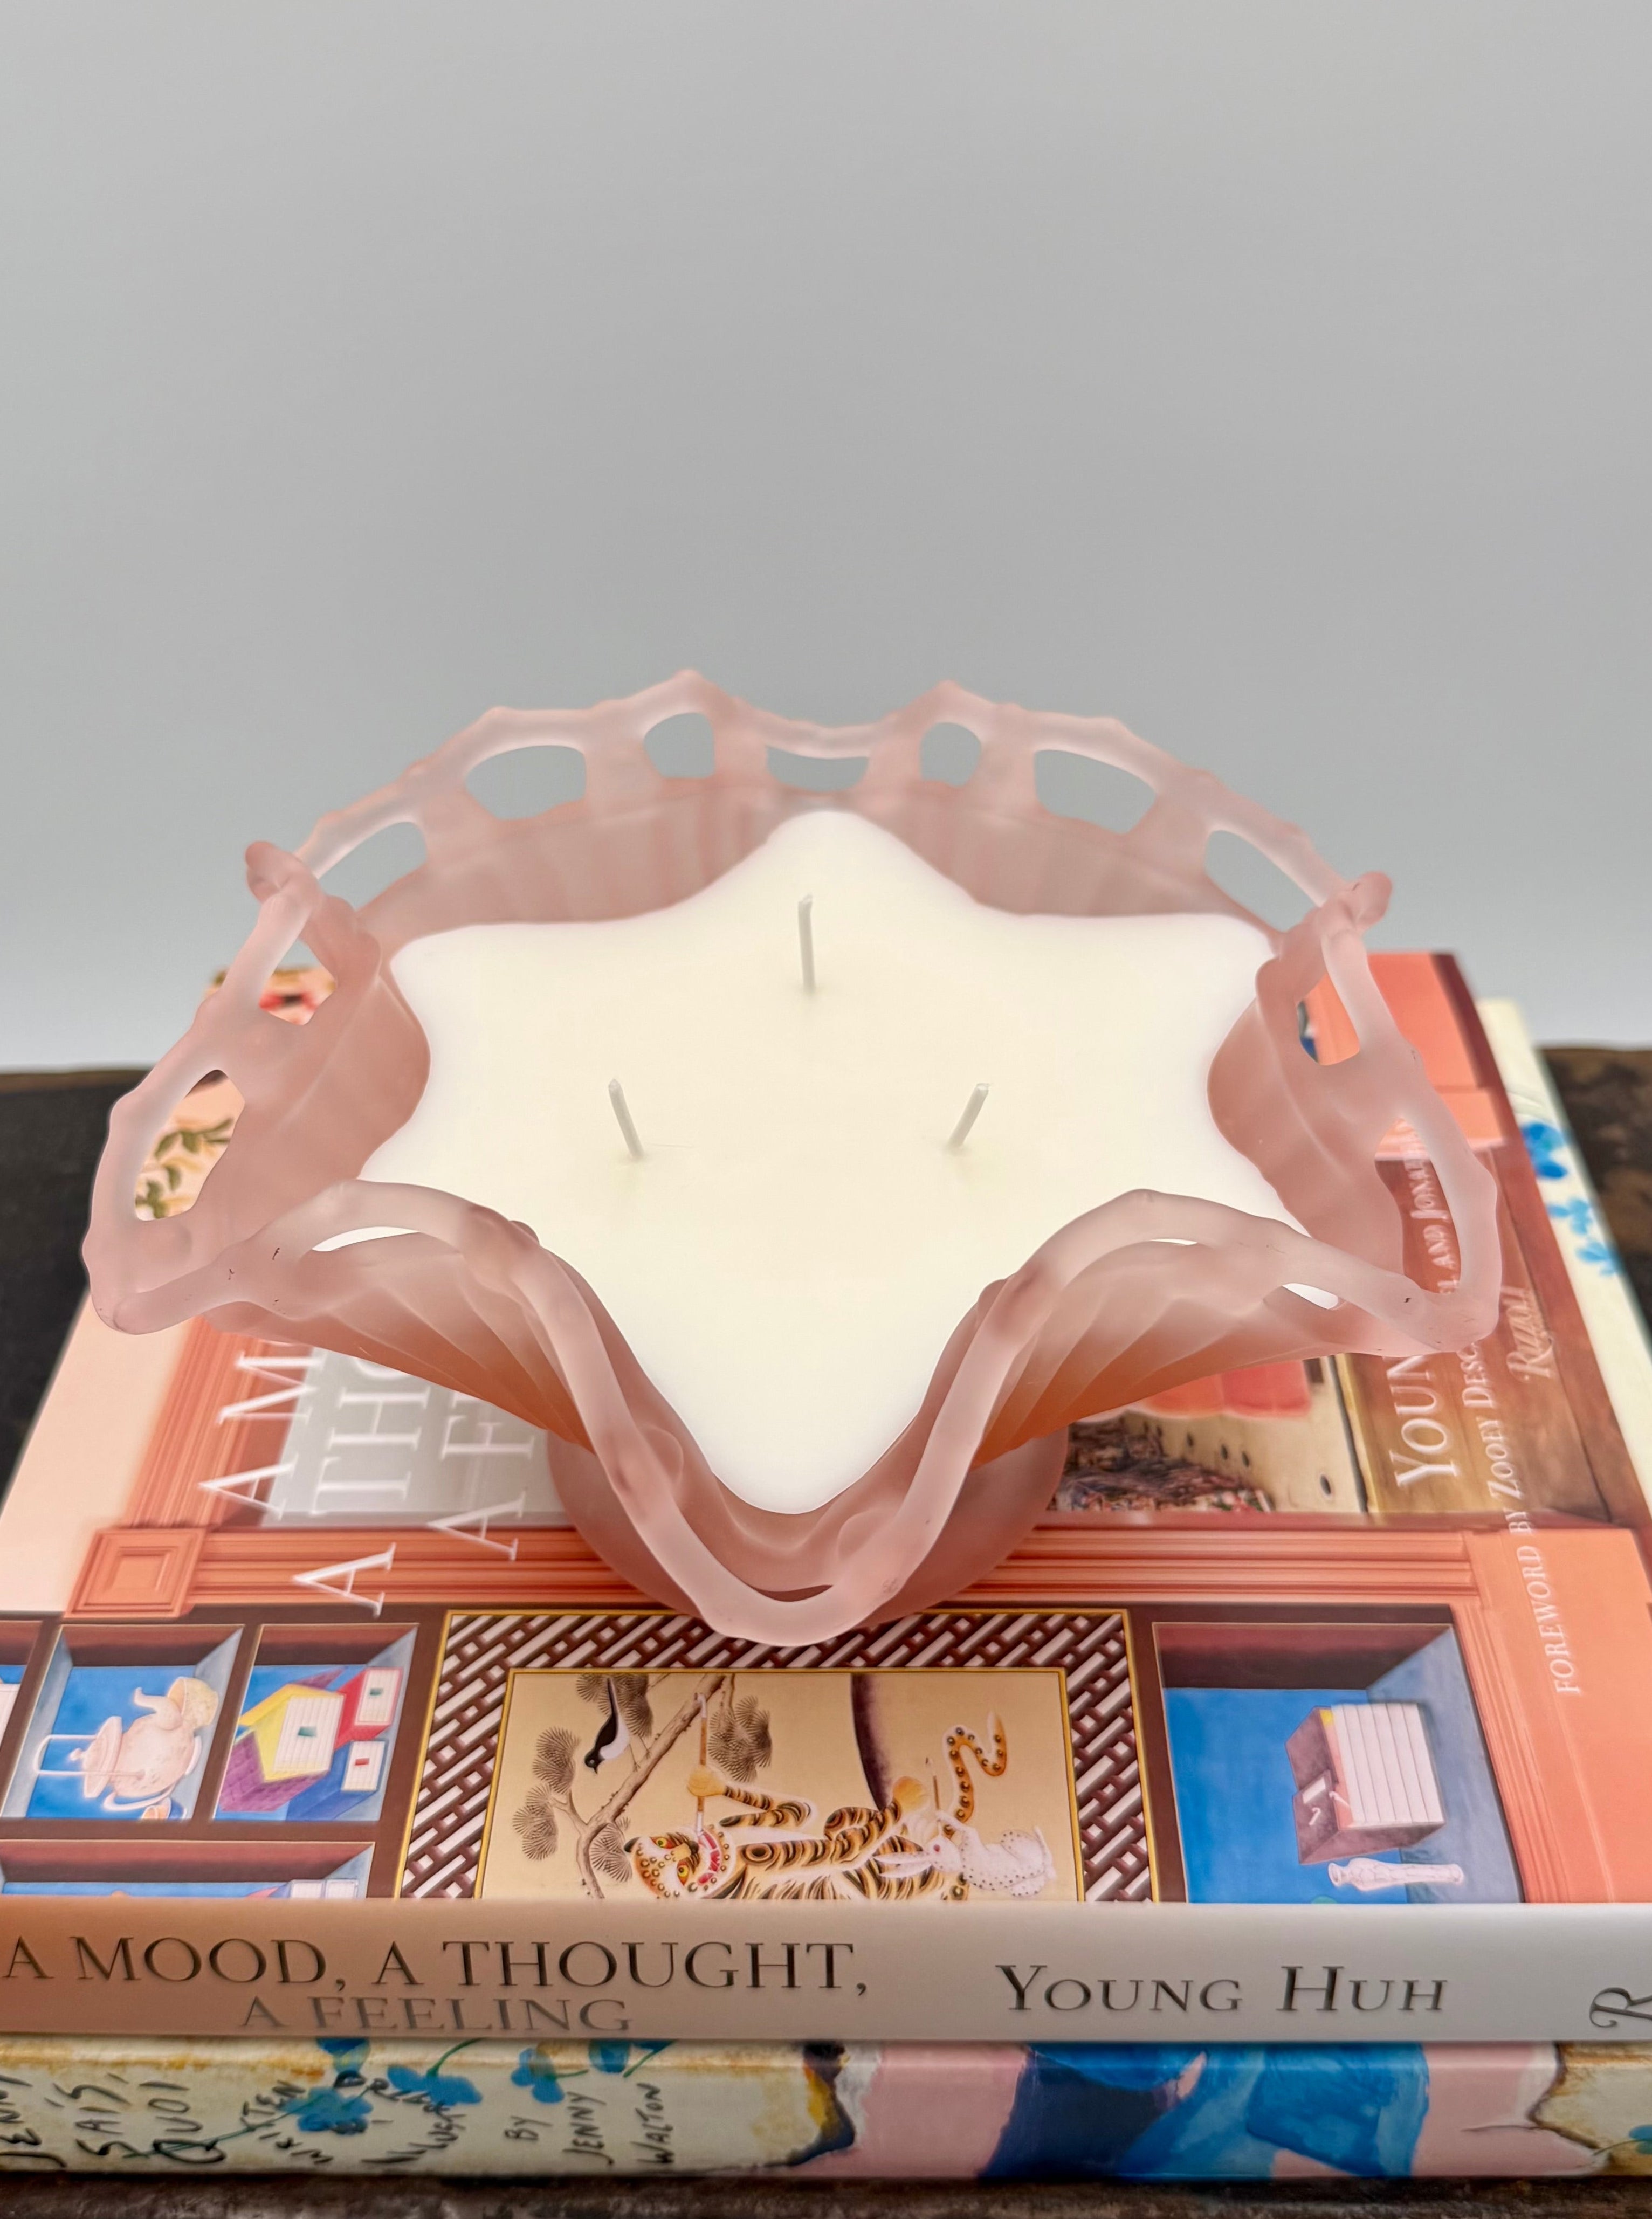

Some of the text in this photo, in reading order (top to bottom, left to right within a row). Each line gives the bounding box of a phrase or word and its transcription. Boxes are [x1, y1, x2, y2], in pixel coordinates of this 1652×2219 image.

[1389, 1355, 1460, 1487] YOUN
[198, 1452, 299, 1521] A
[1479, 1416, 1524, 1501] ZOOEY
[428, 1492, 527, 1562] A
[1505, 1508, 1536, 1536] BY
[291, 1542, 397, 1618] A
[1516, 1546, 1582, 1694] FOREWORD
[1, 1936, 867, 1996] A MOOD, A THOUGHT,
[240, 1995, 634, 2032] A FEELING
[504, 2115, 553, 2142] BY
[563, 2091, 615, 2167] JENNY
[631, 2082, 674, 2165] WALTON
